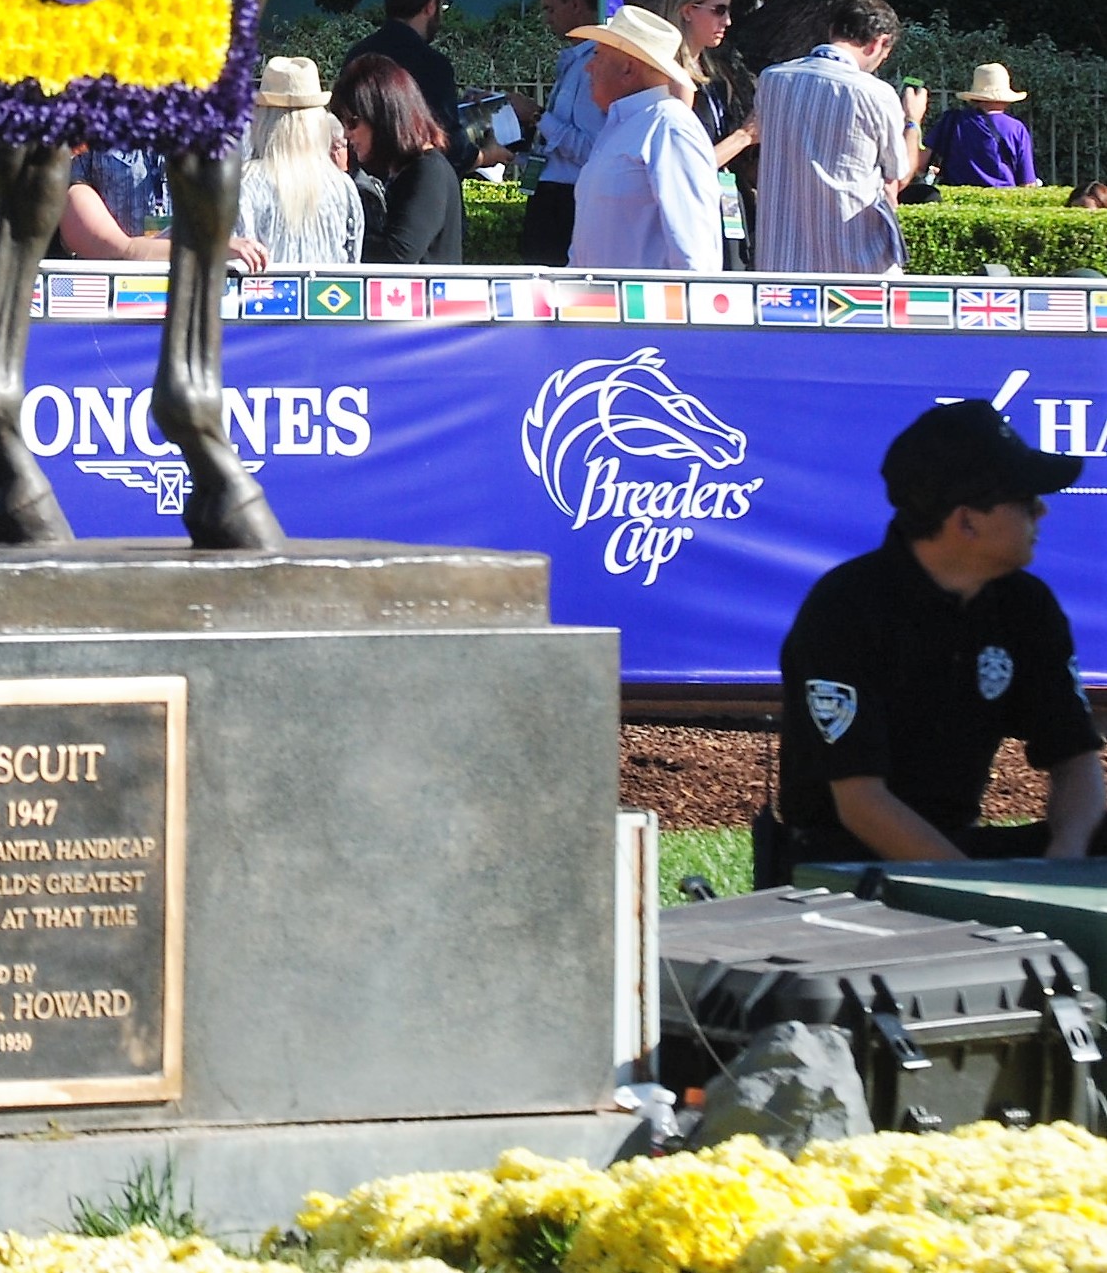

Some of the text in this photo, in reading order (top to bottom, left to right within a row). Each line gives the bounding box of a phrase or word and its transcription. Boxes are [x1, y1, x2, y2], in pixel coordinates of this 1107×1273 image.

[571, 455, 765, 531] Breeders'
[7, 798, 59, 828] 1947
[55, 836, 157, 861] HANDICAP
[45, 870, 147, 895] GREATEST
[1, 906, 29, 930] AT
[31, 904, 86, 929] THAT
[88, 903, 139, 928] TIME
[13, 963, 37, 984] BY
[13, 988, 133, 1021] HOWARD
[0, 1031, 33, 1053] 1950
